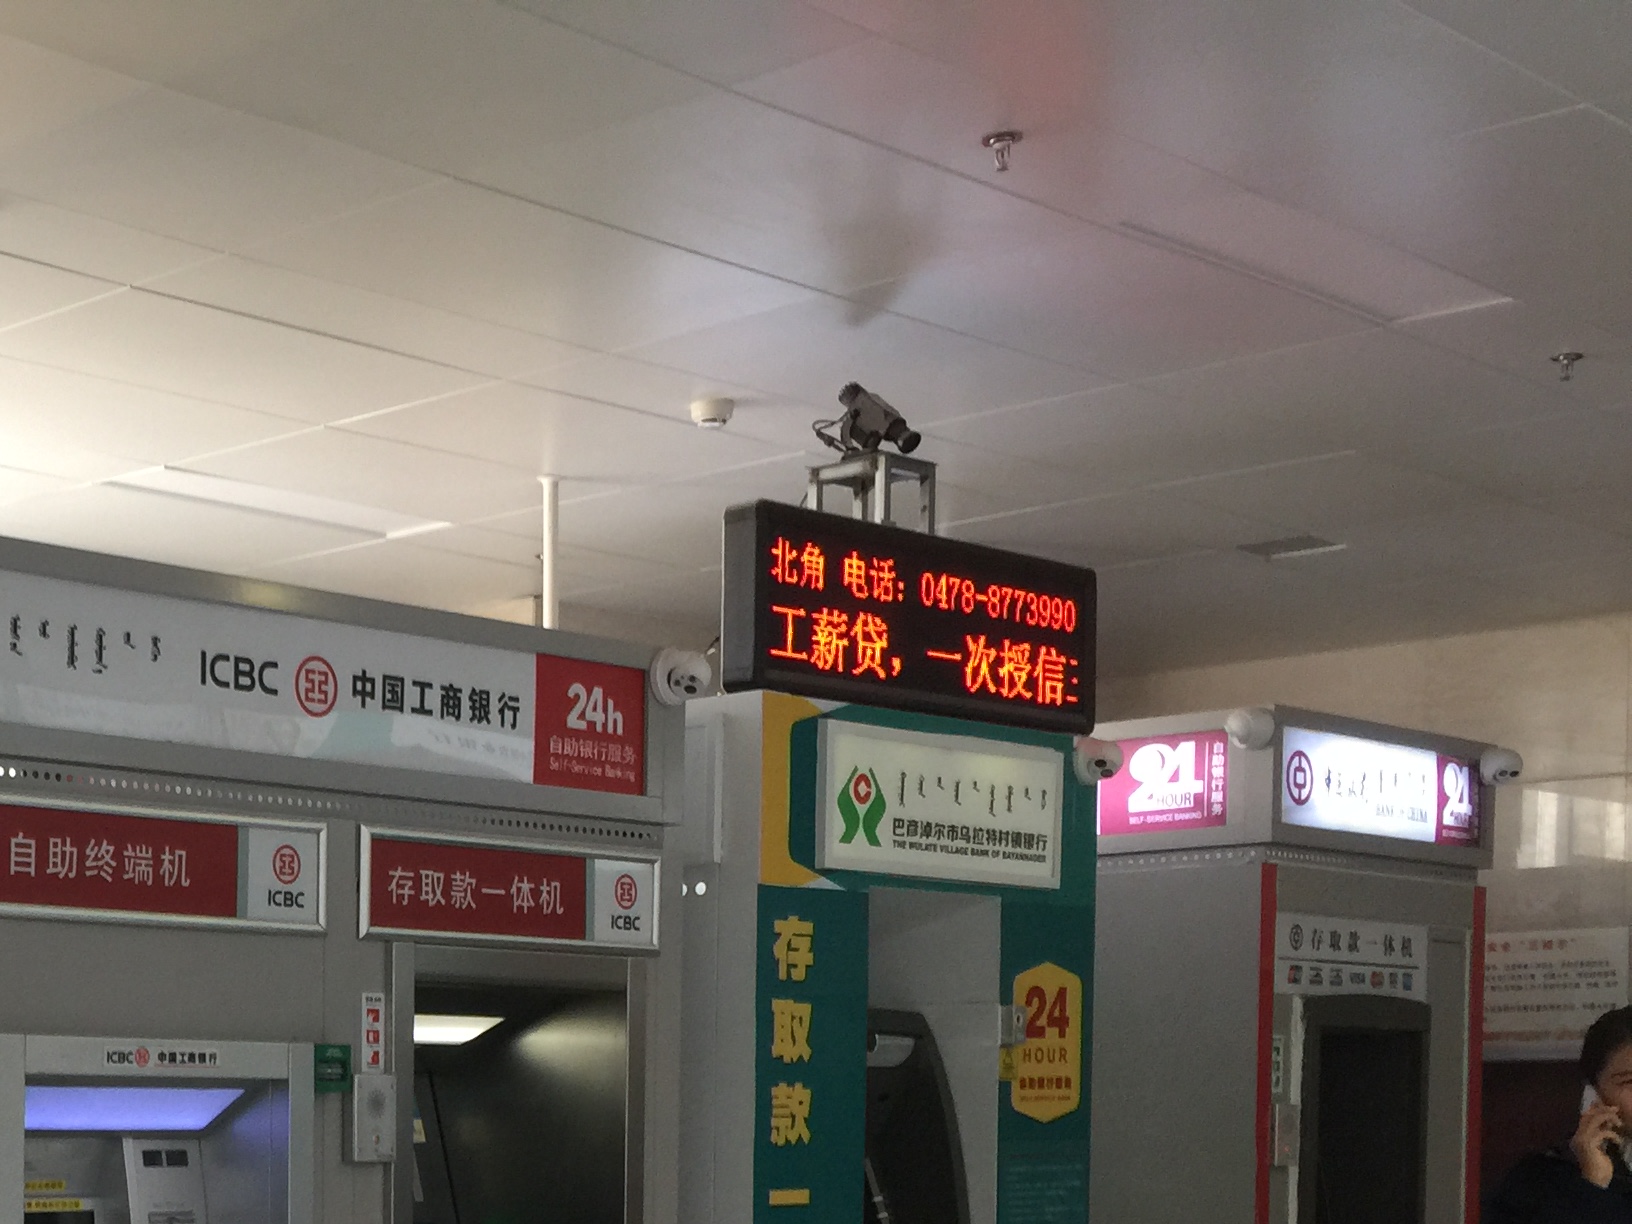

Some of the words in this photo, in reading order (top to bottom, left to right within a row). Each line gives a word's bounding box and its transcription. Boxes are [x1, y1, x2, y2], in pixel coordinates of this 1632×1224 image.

[771, 537, 825, 591] 北角
[921, 572, 1077, 633] 0478-8773990
[200, 648, 279, 698] ICBC
[351, 669, 521, 732] 中国工商银行
[567, 683, 624, 737] 24h
[549, 735, 636, 765] 自助银行服务
[893, 818, 1048, 851] 巴彦淖尔市乌拉特村镇银行
[9, 832, 191, 889] 自助终端机
[266, 890, 305, 909] ICBC
[387, 866, 565, 916] 存取款一体机
[610, 915, 641, 932] ICBC
[1025, 985, 1070, 1039] 24
[106, 1050, 133, 1064] ICBC
[1023, 1047, 1068, 1064] HOUR
